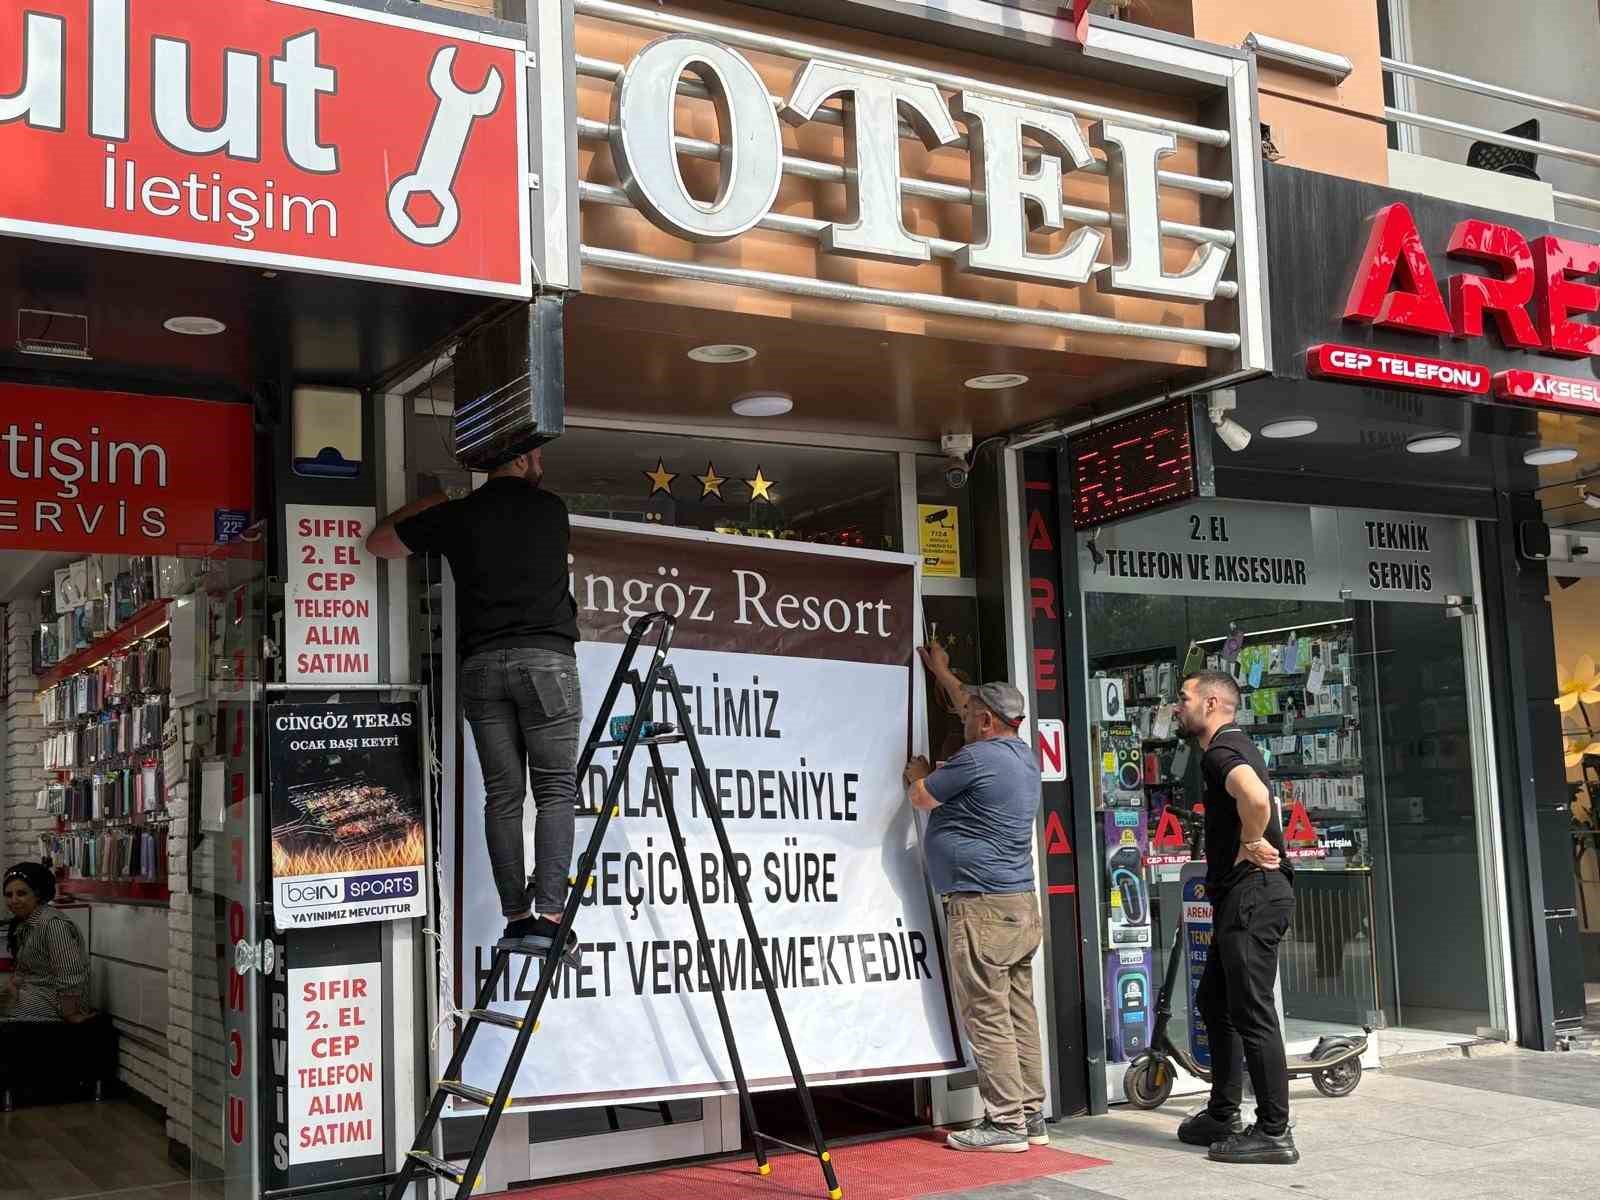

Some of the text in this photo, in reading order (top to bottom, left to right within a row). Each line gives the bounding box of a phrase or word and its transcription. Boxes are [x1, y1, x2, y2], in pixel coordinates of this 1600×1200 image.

[610, 33, 1231, 302] OTEL
[105, 143, 338, 243] İletişim
[1343, 201, 1600, 360] ARE
[1330, 351, 1481, 387] CEP TELEFONU
[1, 422, 168, 499] tişim
[298, 518, 362, 538] SIFIR
[1190, 515, 1230, 543] 2. EL
[1365, 519, 1430, 552] TEKNİK
[301, 545, 360, 565] 2. EL
[1105, 549, 1307, 586] TELEFON VE AKSESUAR
[307, 572, 356, 591] CEP
[1368, 560, 1433, 591] SERVİS
[294, 599, 369, 618] TELEFON
[568, 553, 892, 639] ingöz Resort
[305, 626, 360, 645] ALIM
[297, 653, 369, 674] SATIMI
[638, 672, 782, 739] TELİMİZ
[276, 712, 412, 731] CİNGÖZ TERAS
[290, 737, 399, 751] OCAK BAŞI KEYFİ
[690, 756, 859, 821] NEDENİYLE
[763, 837, 838, 904] SÜRE
[287, 877, 413, 903] beIN SPORTS
[291, 904, 411, 924] YAYINIMIZ MEVCUTTUR
[303, 978, 367, 1002] SIFIR
[305, 1006, 366, 1031] 2. EL
[311, 1035, 360, 1059] CEP
[298, 1062, 373, 1088] TELEFON
[308, 1091, 364, 1116] ALIM
[299, 1118, 372, 1148] SATIMI
